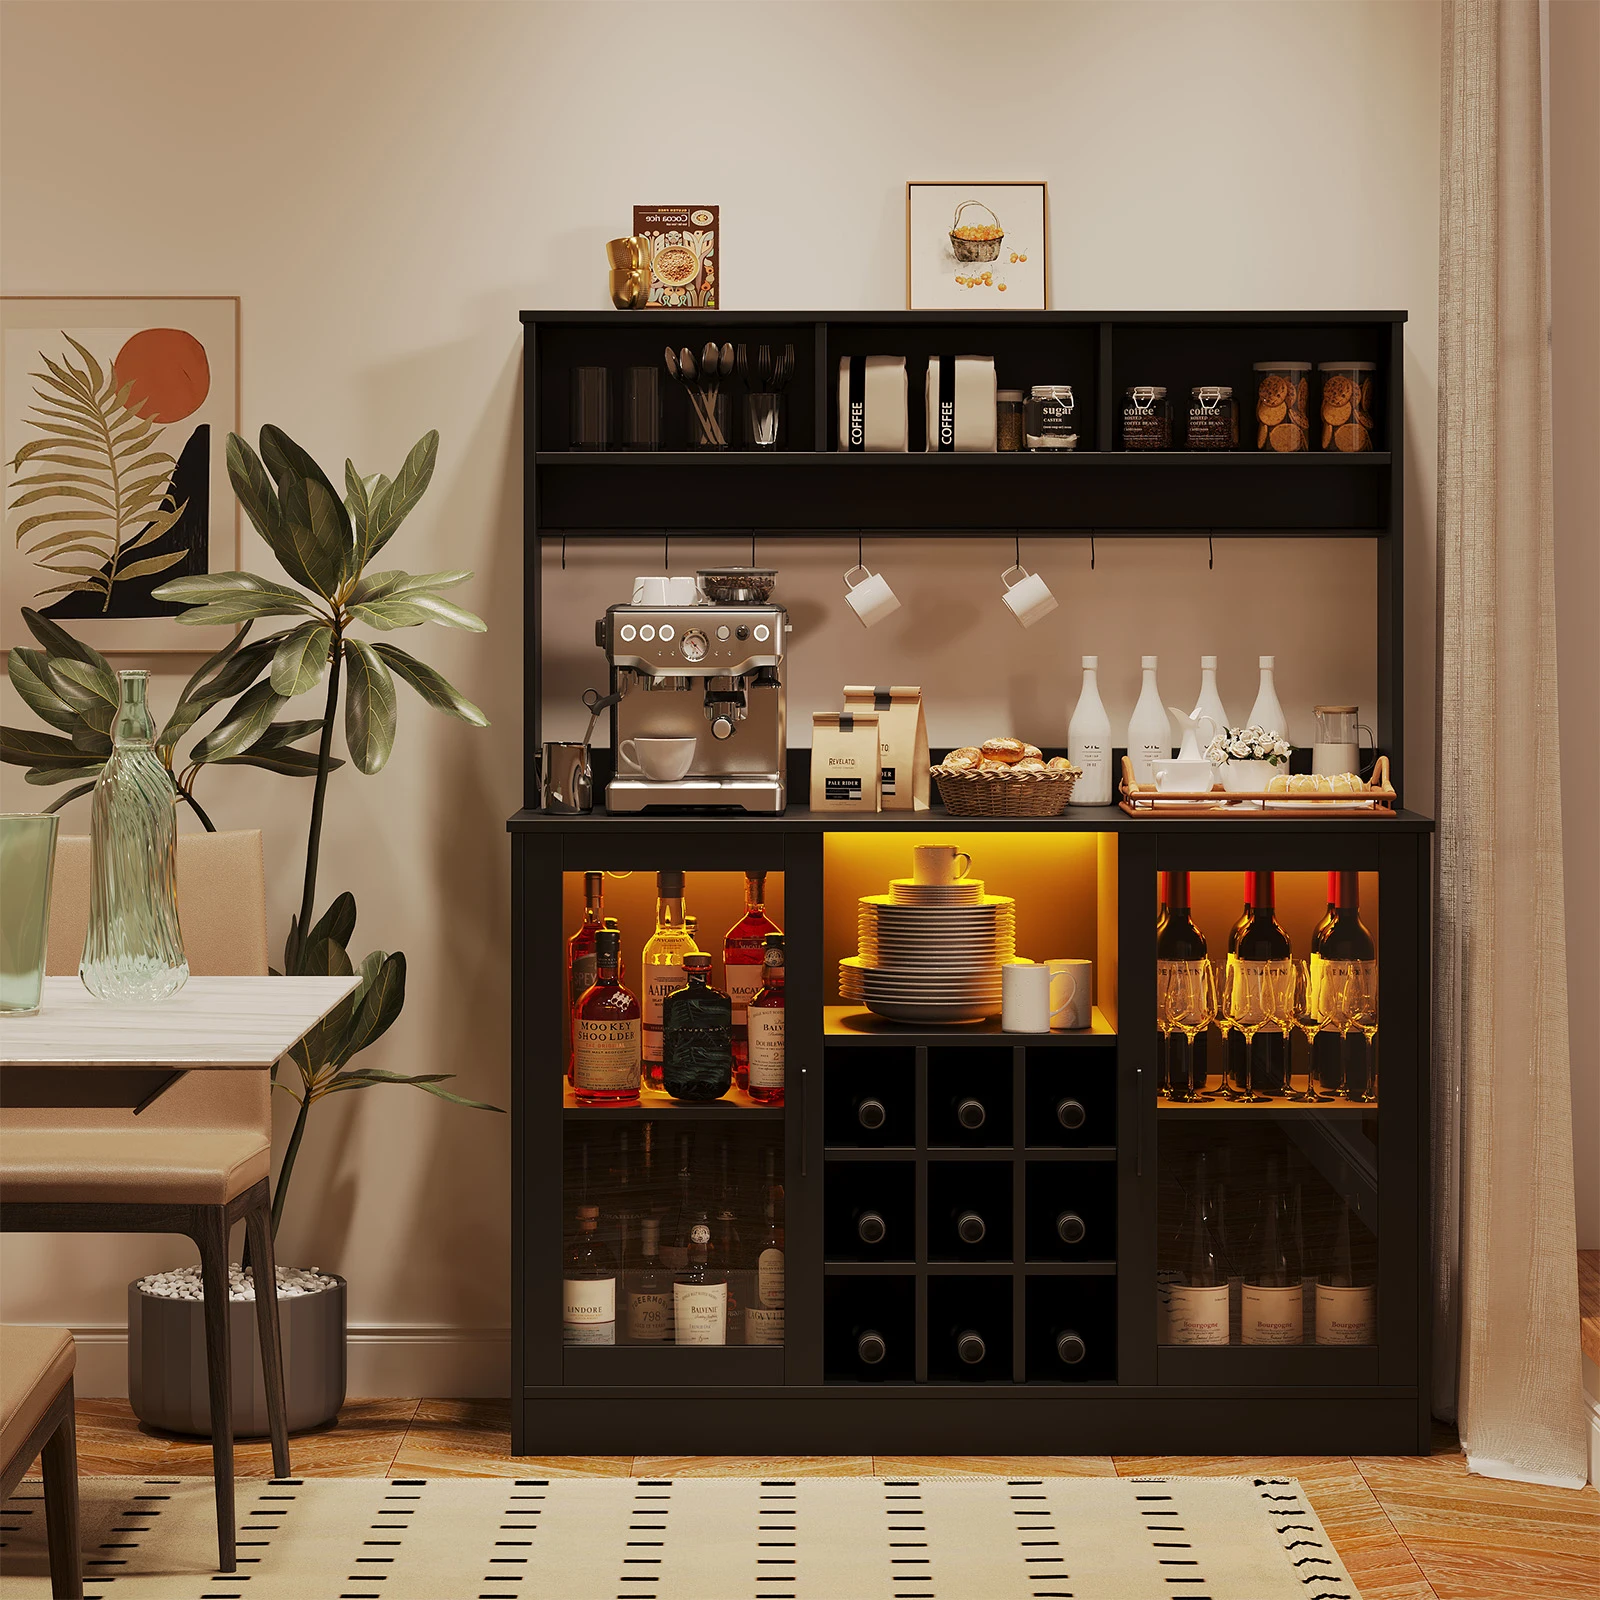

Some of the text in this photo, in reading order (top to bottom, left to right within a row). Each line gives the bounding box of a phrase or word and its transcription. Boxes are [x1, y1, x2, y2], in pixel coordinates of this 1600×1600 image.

[1042, 407, 1073, 418] sugar
[851, 402, 863, 445] COFFEE
[941, 402, 953, 445] COFFEE
[828, 757, 855, 766] REVELATO
[642, 1311, 661, 1322] 798
